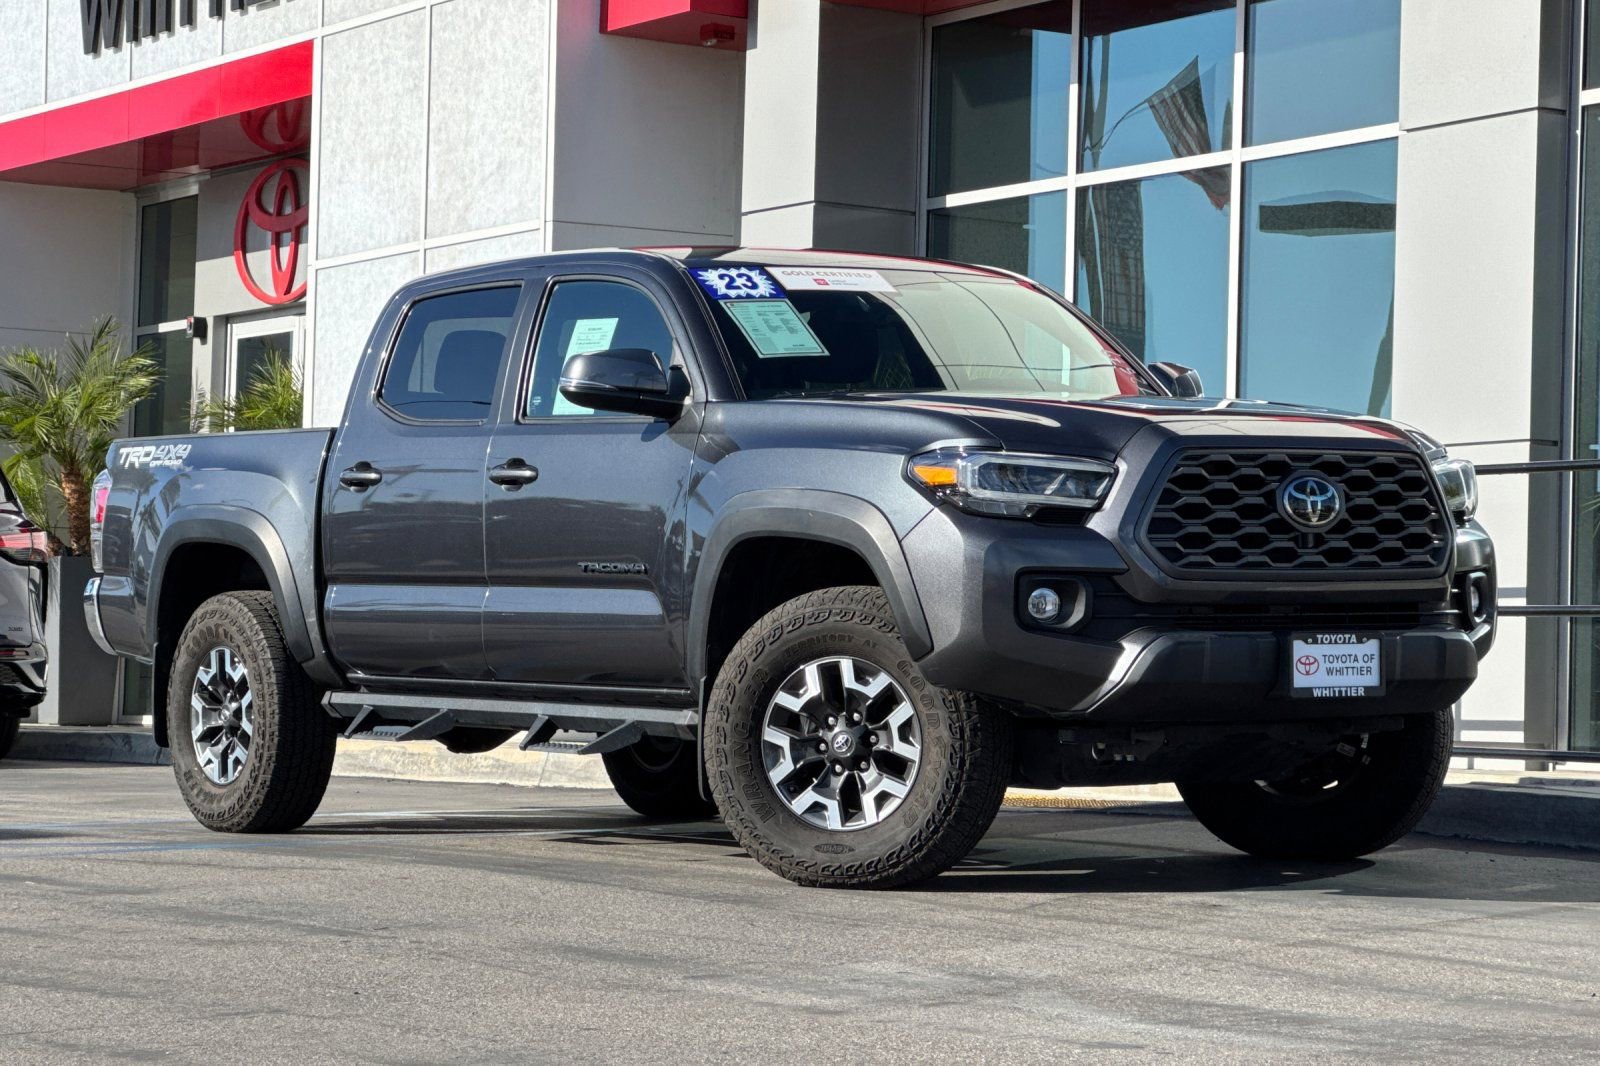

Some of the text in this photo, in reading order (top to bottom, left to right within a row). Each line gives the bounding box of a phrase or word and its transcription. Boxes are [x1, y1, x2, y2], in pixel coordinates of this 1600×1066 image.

[816, 271, 873, 279] CERTIFIED
[717, 272, 760, 291] 23
[119, 445, 156, 469] TRD
[577, 562, 649, 574] TACOMA
[1316, 634, 1358, 644] TOYOTA
[1322, 653, 1376, 664] TOYOTA OF
[1326, 666, 1372, 676] WHITTIER
[1312, 687, 1365, 697] WHITTIER
[733, 668, 776, 823] WRANGLER
[897, 660, 946, 828] GOODYEAR
